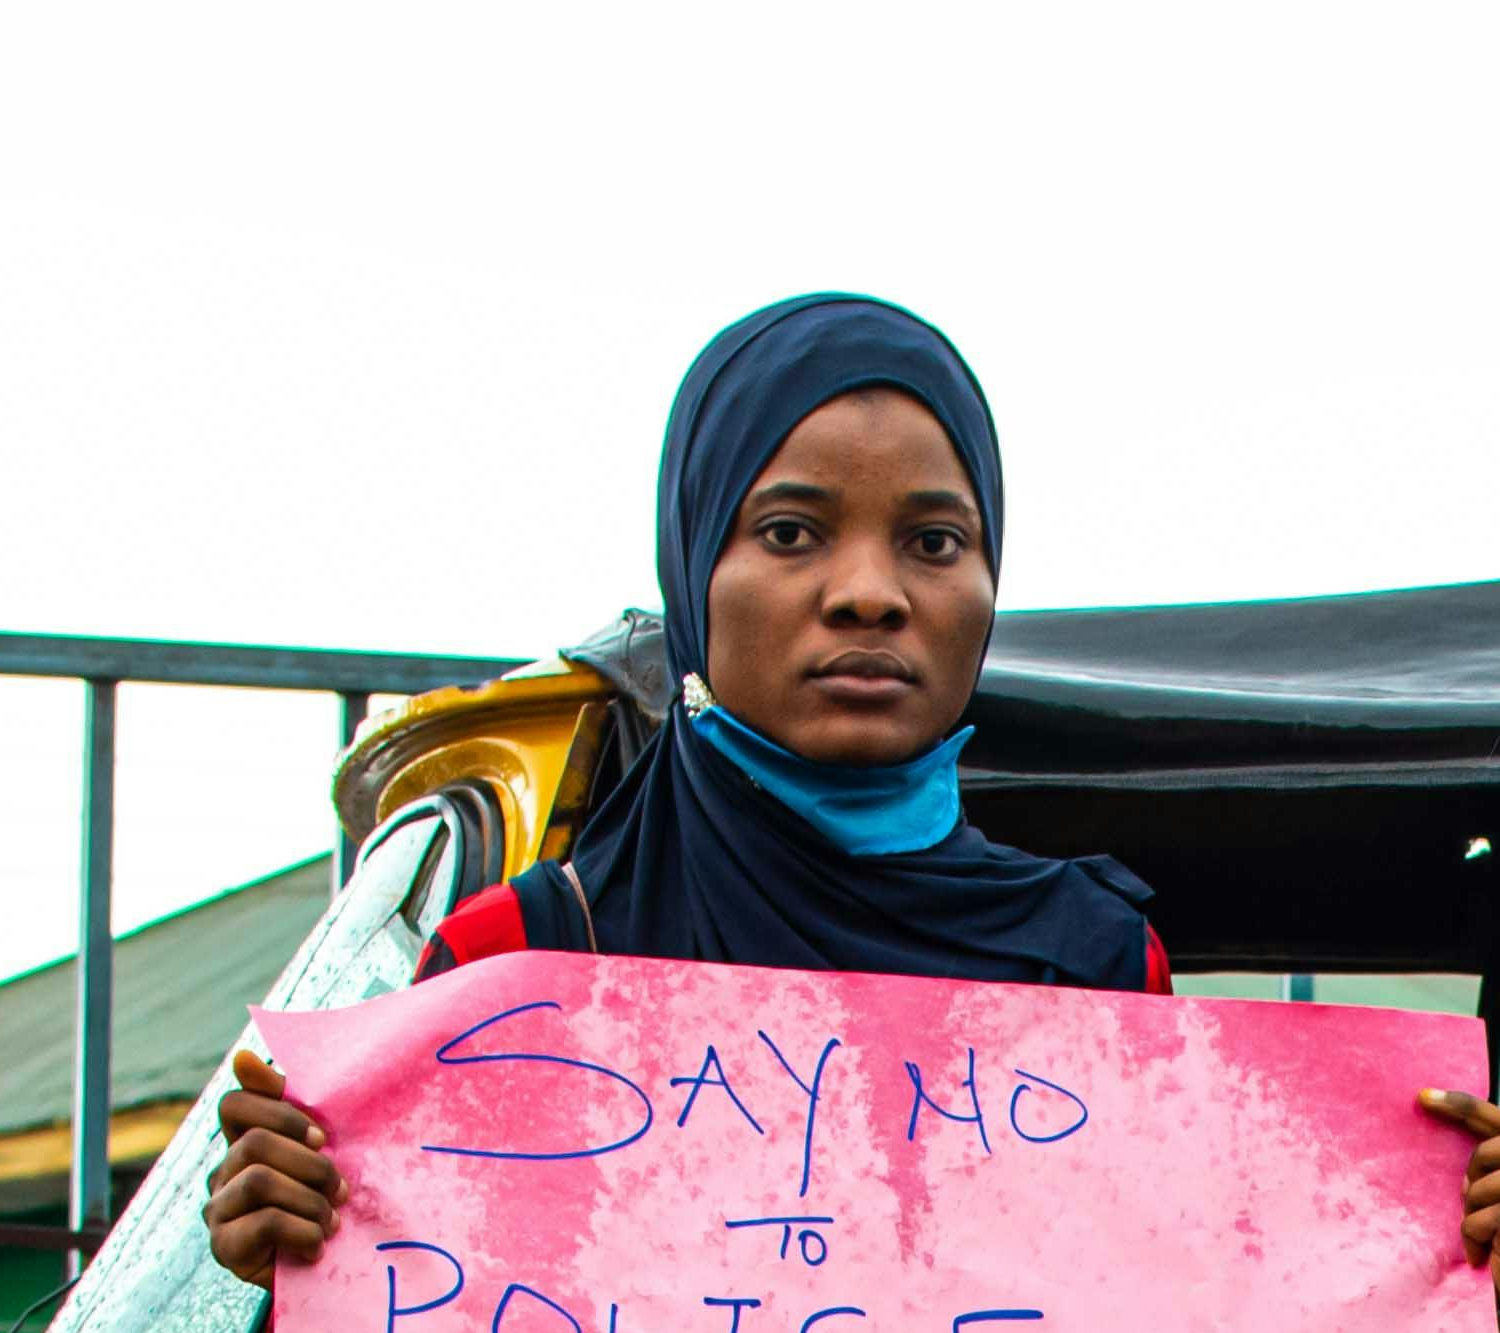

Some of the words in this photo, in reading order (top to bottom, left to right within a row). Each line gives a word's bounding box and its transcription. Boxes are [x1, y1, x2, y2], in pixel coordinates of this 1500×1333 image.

[421, 1002, 840, 1197] SAY
[905, 1048, 1088, 1152] NO
[725, 1217, 833, 1265] TO
